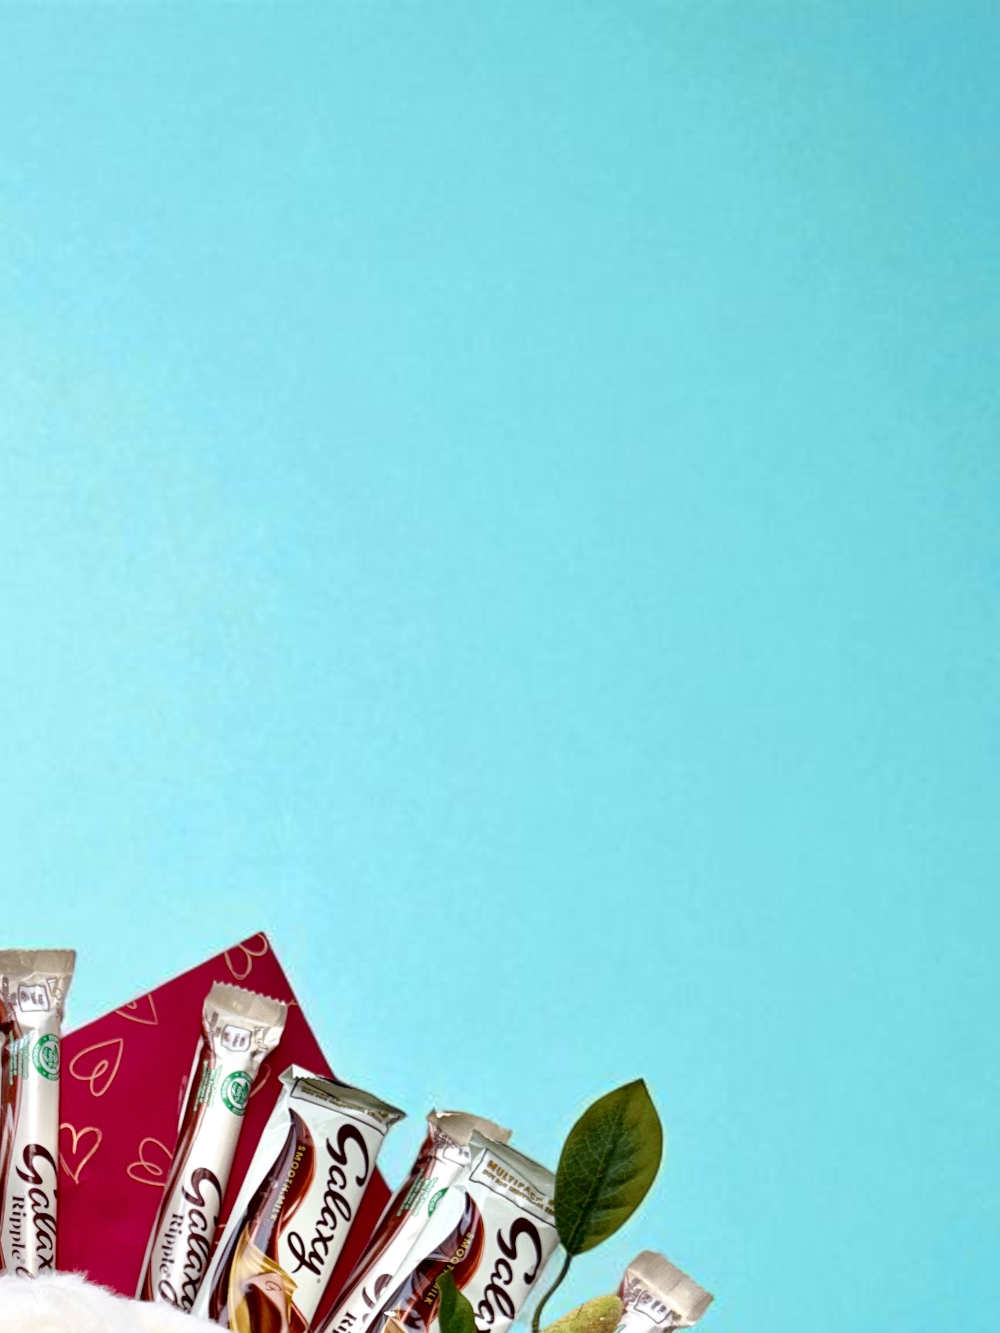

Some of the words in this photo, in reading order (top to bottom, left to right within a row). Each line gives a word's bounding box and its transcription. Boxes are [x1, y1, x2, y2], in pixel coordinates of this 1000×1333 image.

[285, 1145, 306, 1193] SMOOTH
[15, 1144, 58, 1274] Galax
[271, 1194, 286, 1222] MILK
[287, 1124, 370, 1276] Galaxy
[442, 1232, 475, 1276] SMOOT
[424, 1284, 442, 1305] ILK
